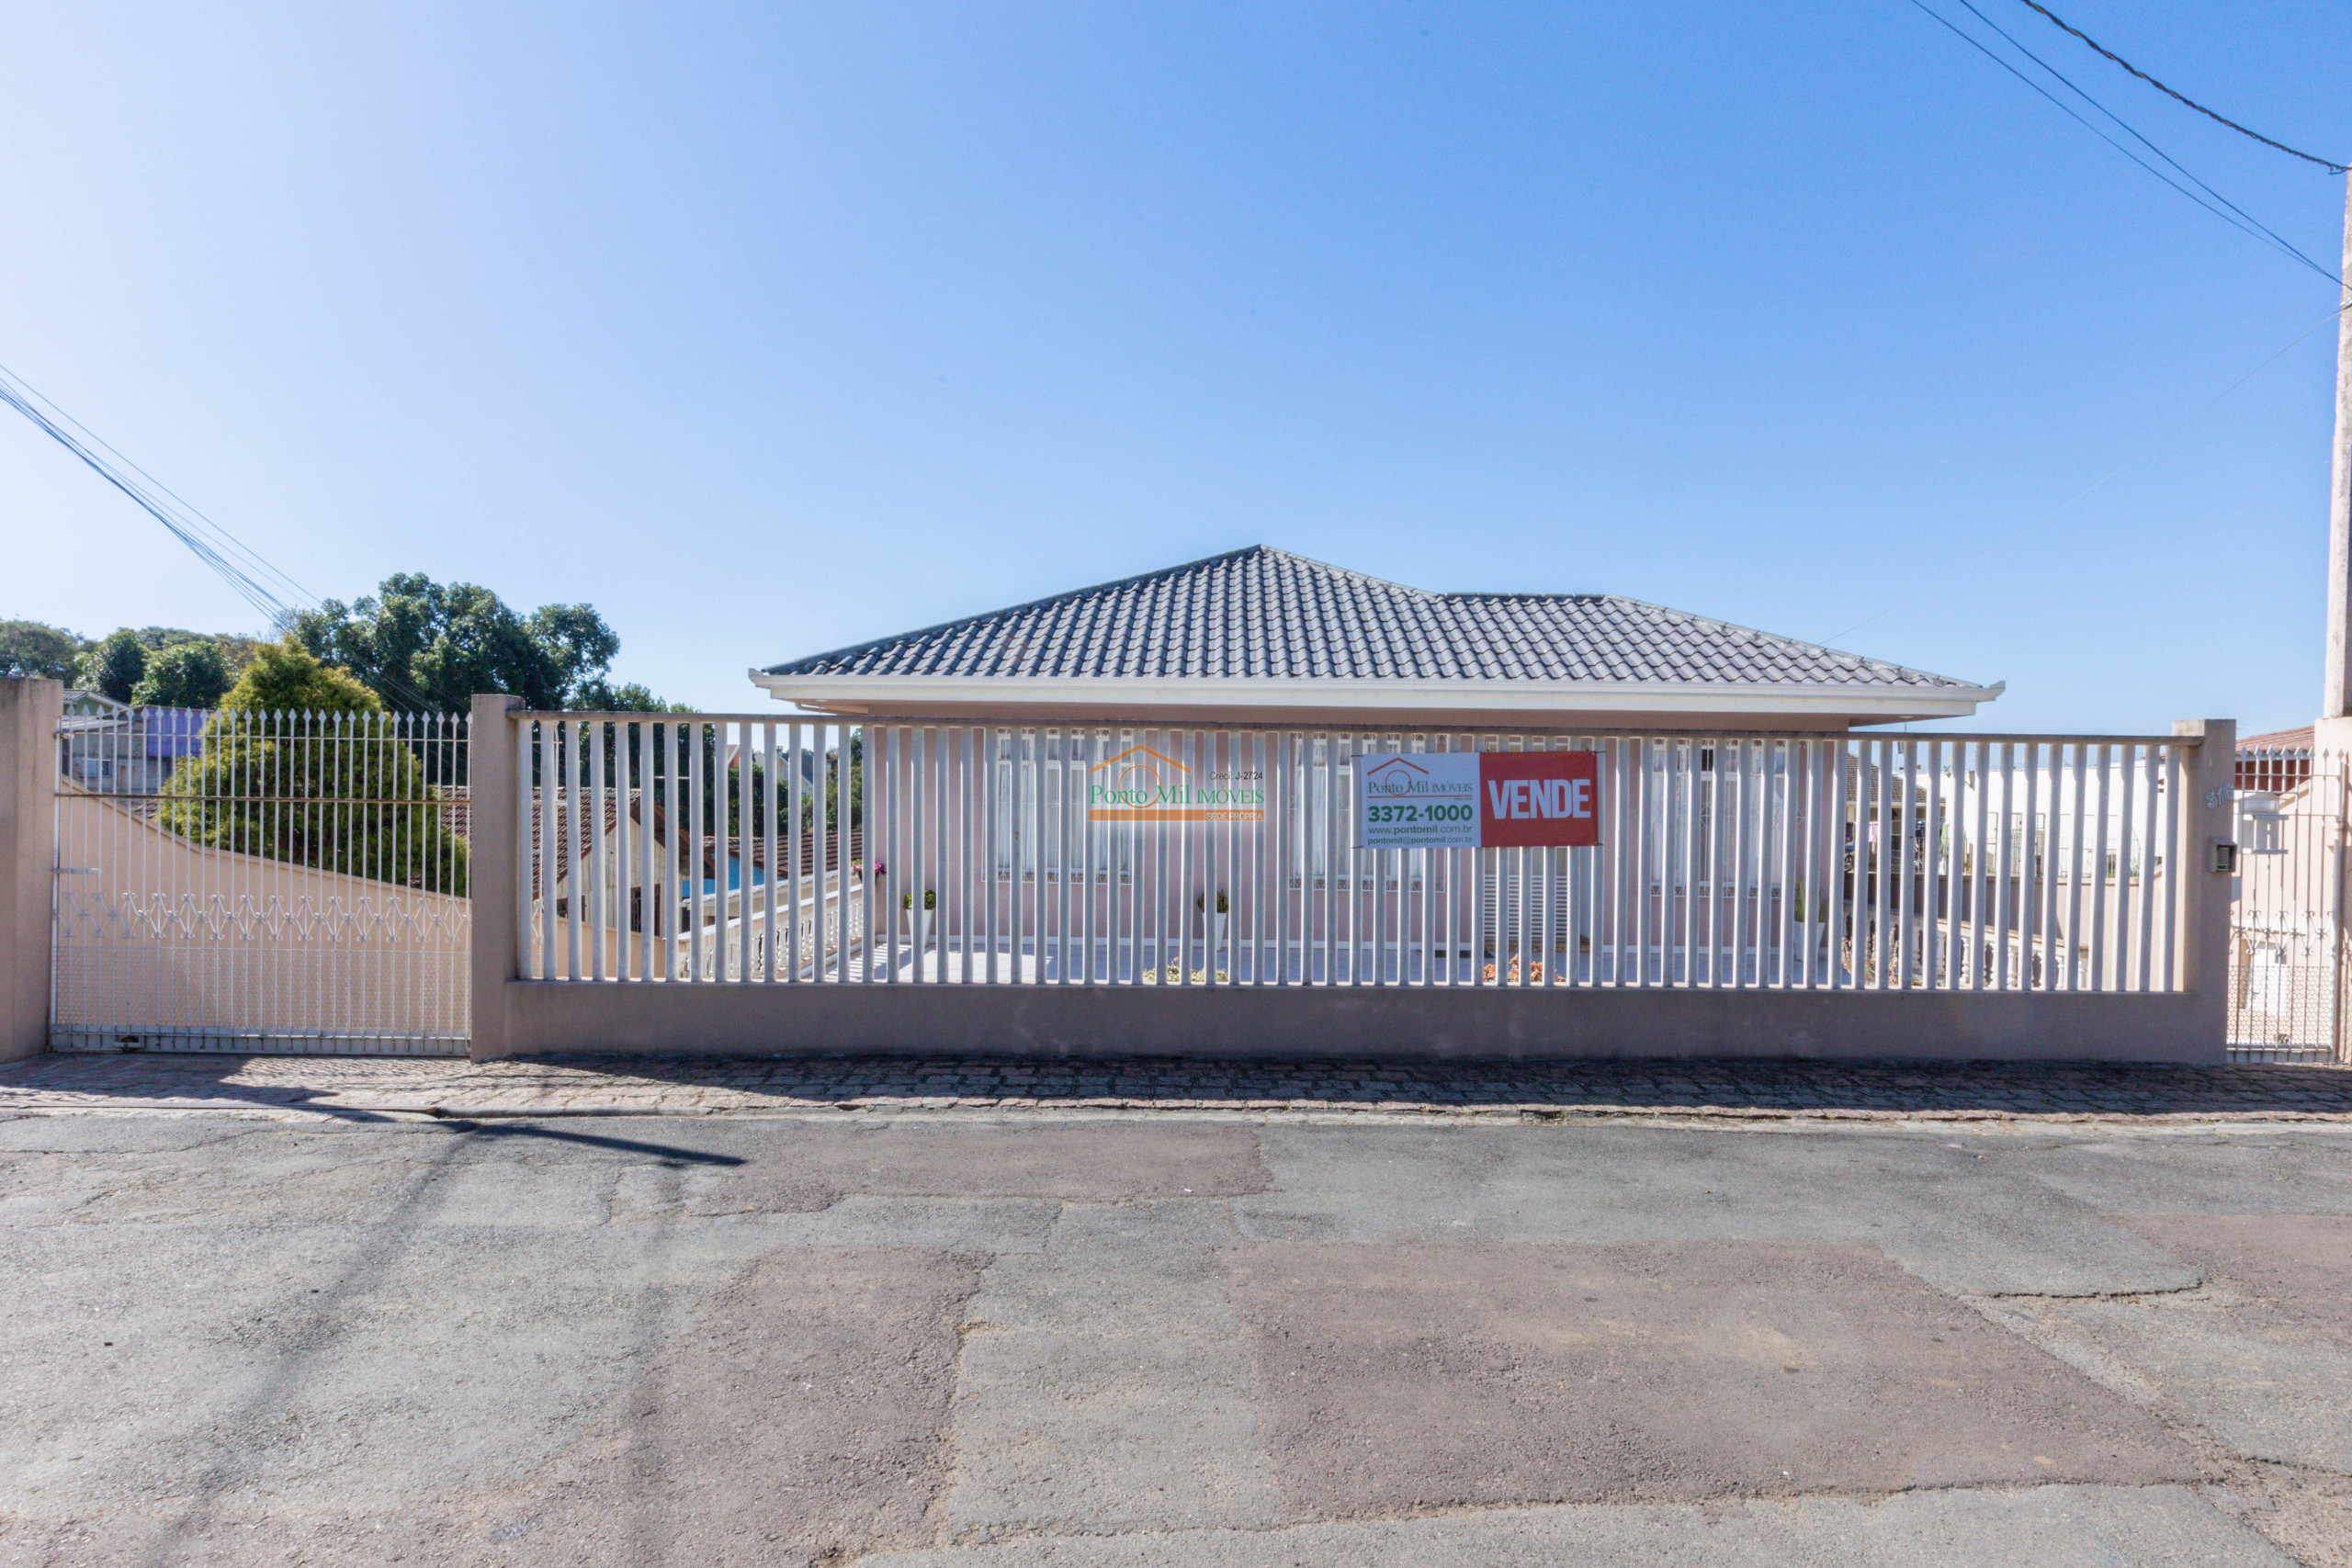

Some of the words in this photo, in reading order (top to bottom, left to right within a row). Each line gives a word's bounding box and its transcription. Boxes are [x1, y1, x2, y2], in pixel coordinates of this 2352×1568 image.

[1368, 781, 1404, 794] Ponto
[1408, 781, 1429, 794] Mil
[1431, 780, 1473, 793] IMÓVEIS
[1487, 779, 1591, 819] VENDE
[1368, 805, 1473, 822] 3372-1000
[1368, 825, 1473, 836] www.pontomil.com.br
[1368, 836, 1473, 846] pontomil@pontomil.com.br
